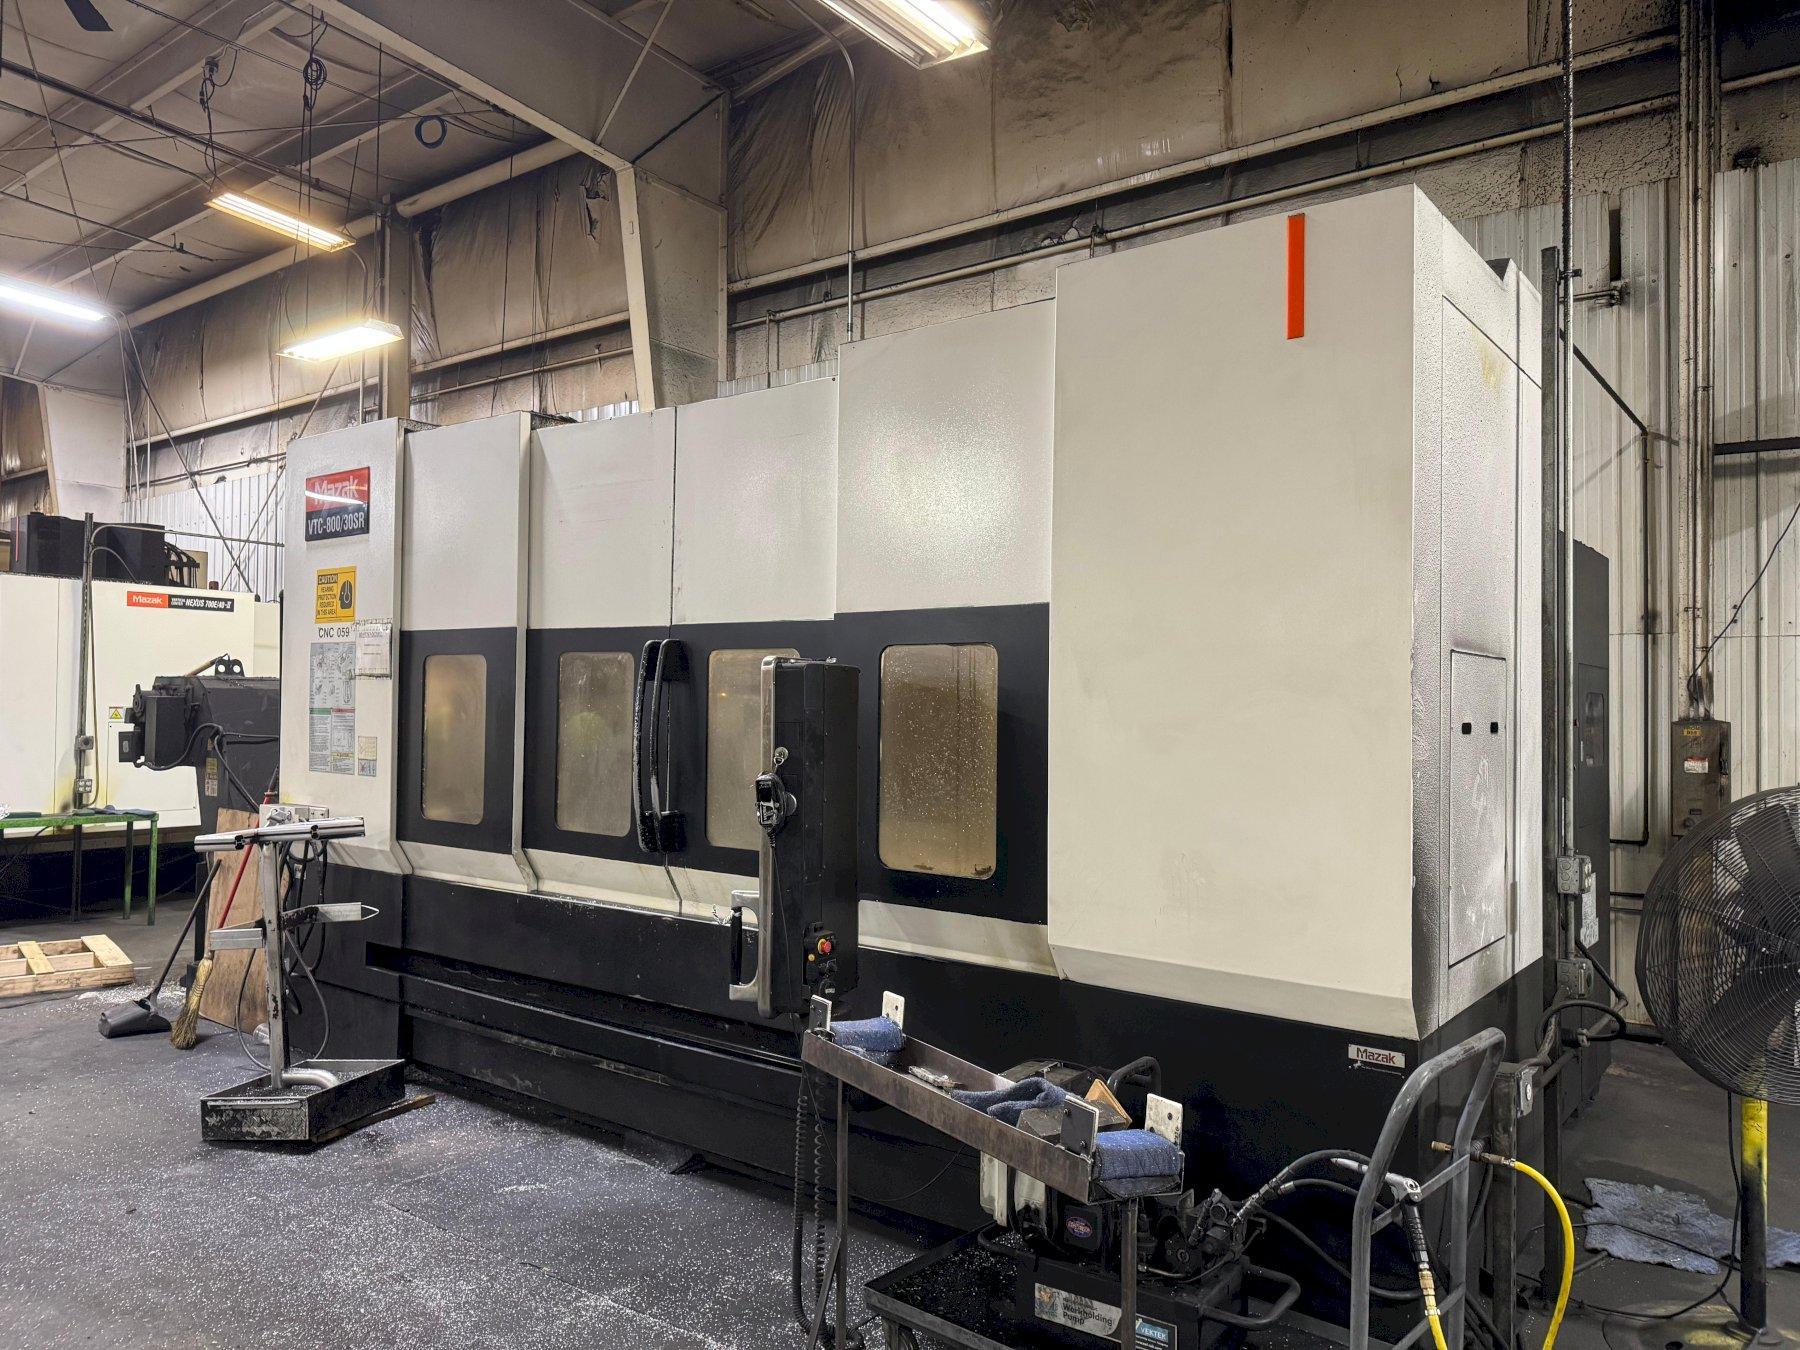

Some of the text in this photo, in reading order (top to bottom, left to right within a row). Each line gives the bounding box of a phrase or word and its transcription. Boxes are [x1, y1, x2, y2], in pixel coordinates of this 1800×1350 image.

[314, 475, 359, 504] Mazak
[308, 511, 365, 535] VTC-800/30SR
[318, 574, 338, 584] CAUTION
[132, 595, 163, 605] Mazak
[185, 598, 204, 607] NEXUS
[318, 627, 334, 638] CNC
[336, 626, 350, 638] 059
[1356, 1047, 1396, 1065] Mazak
[1063, 1303, 1113, 1327] Workholding
[1063, 1311, 1085, 1325] Pump
[1140, 1327, 1166, 1340] VEKTEK
